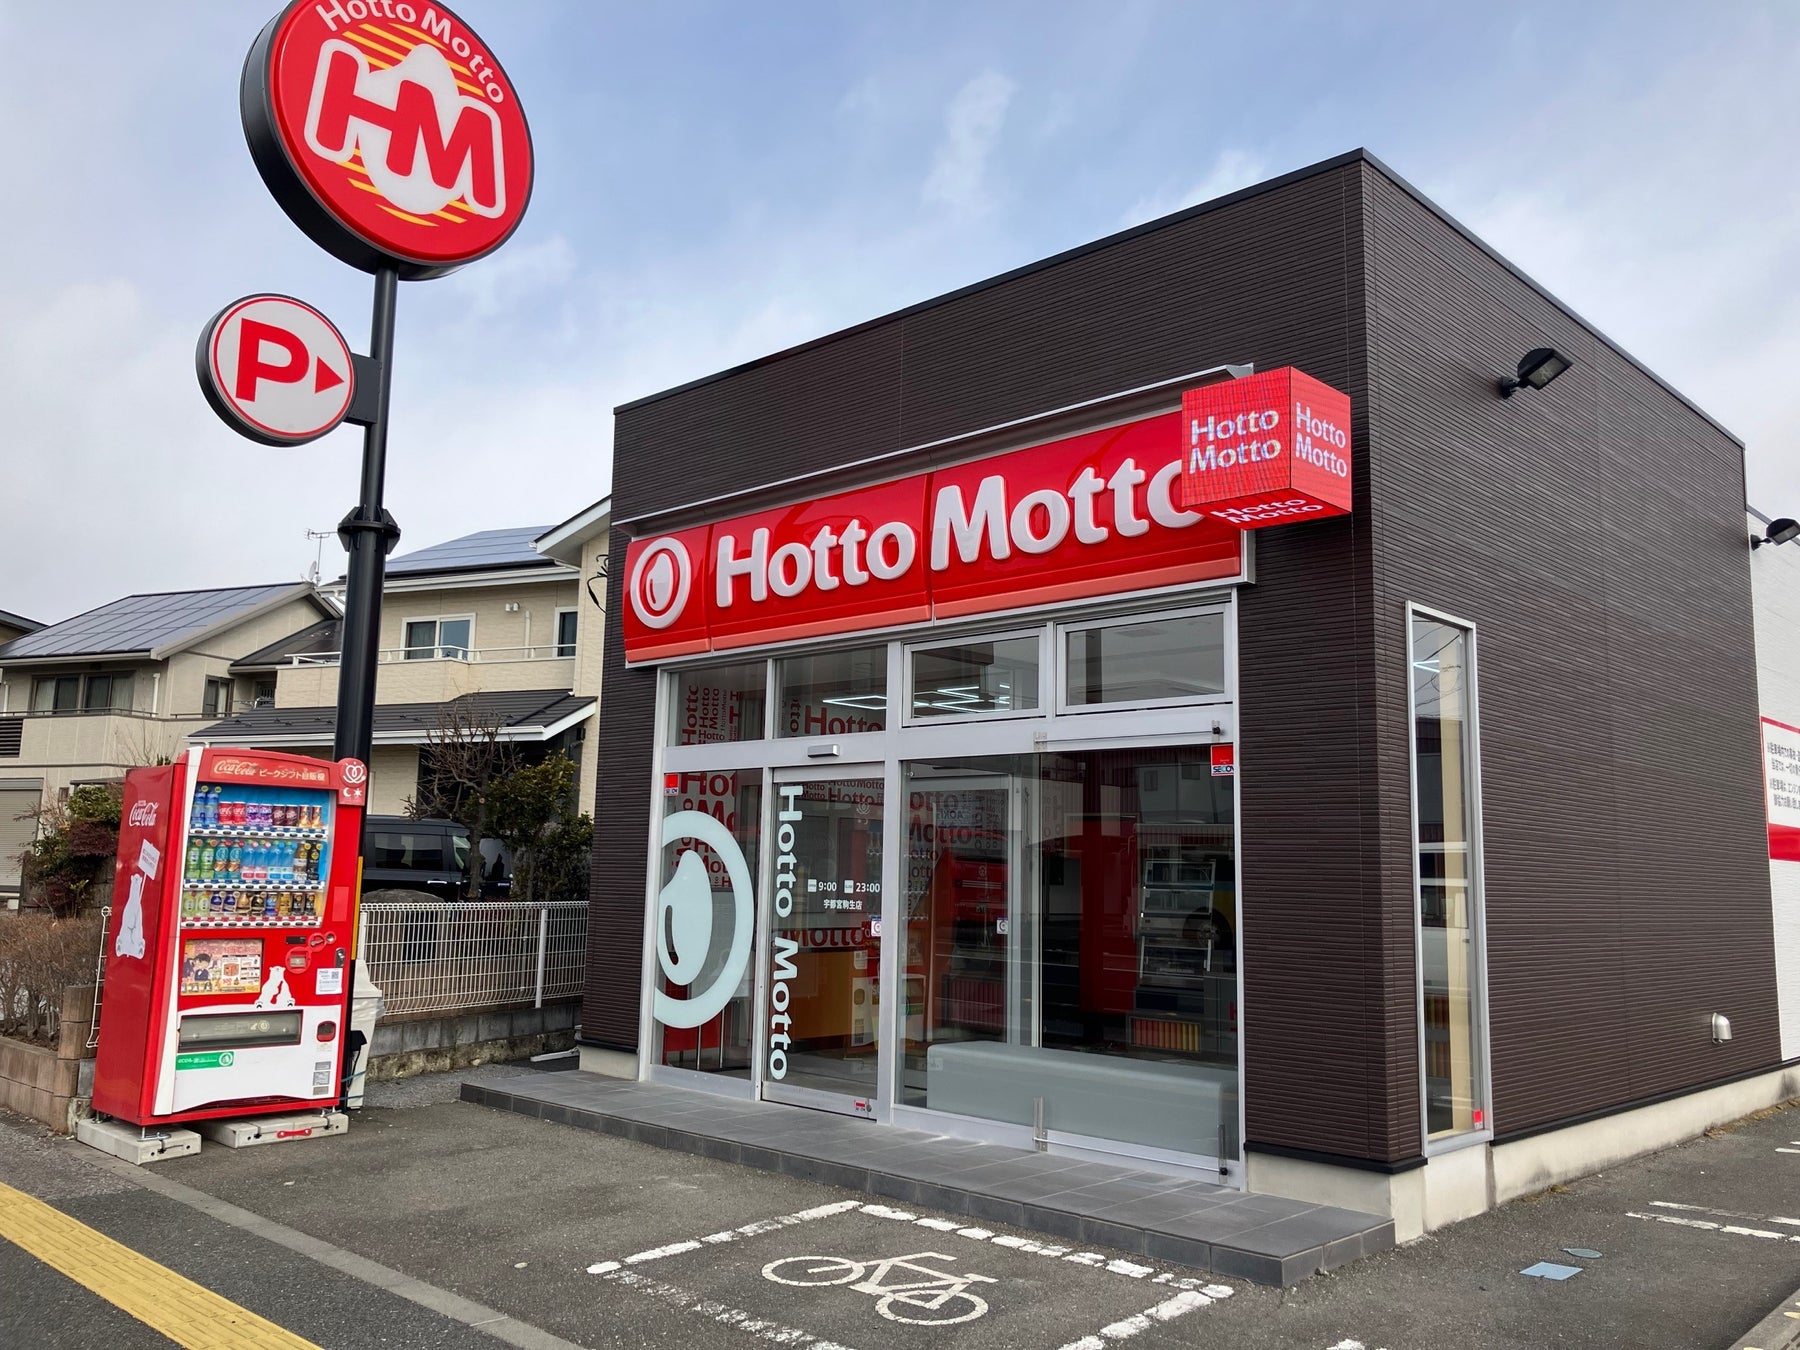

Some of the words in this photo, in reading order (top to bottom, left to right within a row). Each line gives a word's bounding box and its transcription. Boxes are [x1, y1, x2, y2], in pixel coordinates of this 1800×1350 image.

[316, 0, 416, 31] Hotto
[420, 8, 504, 103] Motto
[315, 49, 497, 209] HM
[235, 317, 309, 402] P
[1191, 409, 1279, 446] Hotto
[1296, 401, 1347, 449] Hotto
[1189, 439, 1281, 474] Motto
[1295, 431, 1348, 478] Motto
[1210, 499, 1308, 518] Hotto
[1226, 504, 1324, 524] Motto
[716, 519, 915, 607] Hotto
[699, 687, 710, 729] Hotto
[709, 688, 720, 730] Motto
[699, 729, 725, 741] Hotto
[775, 785, 803, 918] Hotto
[818, 881, 837, 892] 9:00
[855, 882, 881, 893] 23:00
[770, 936, 799, 1080] Motto
